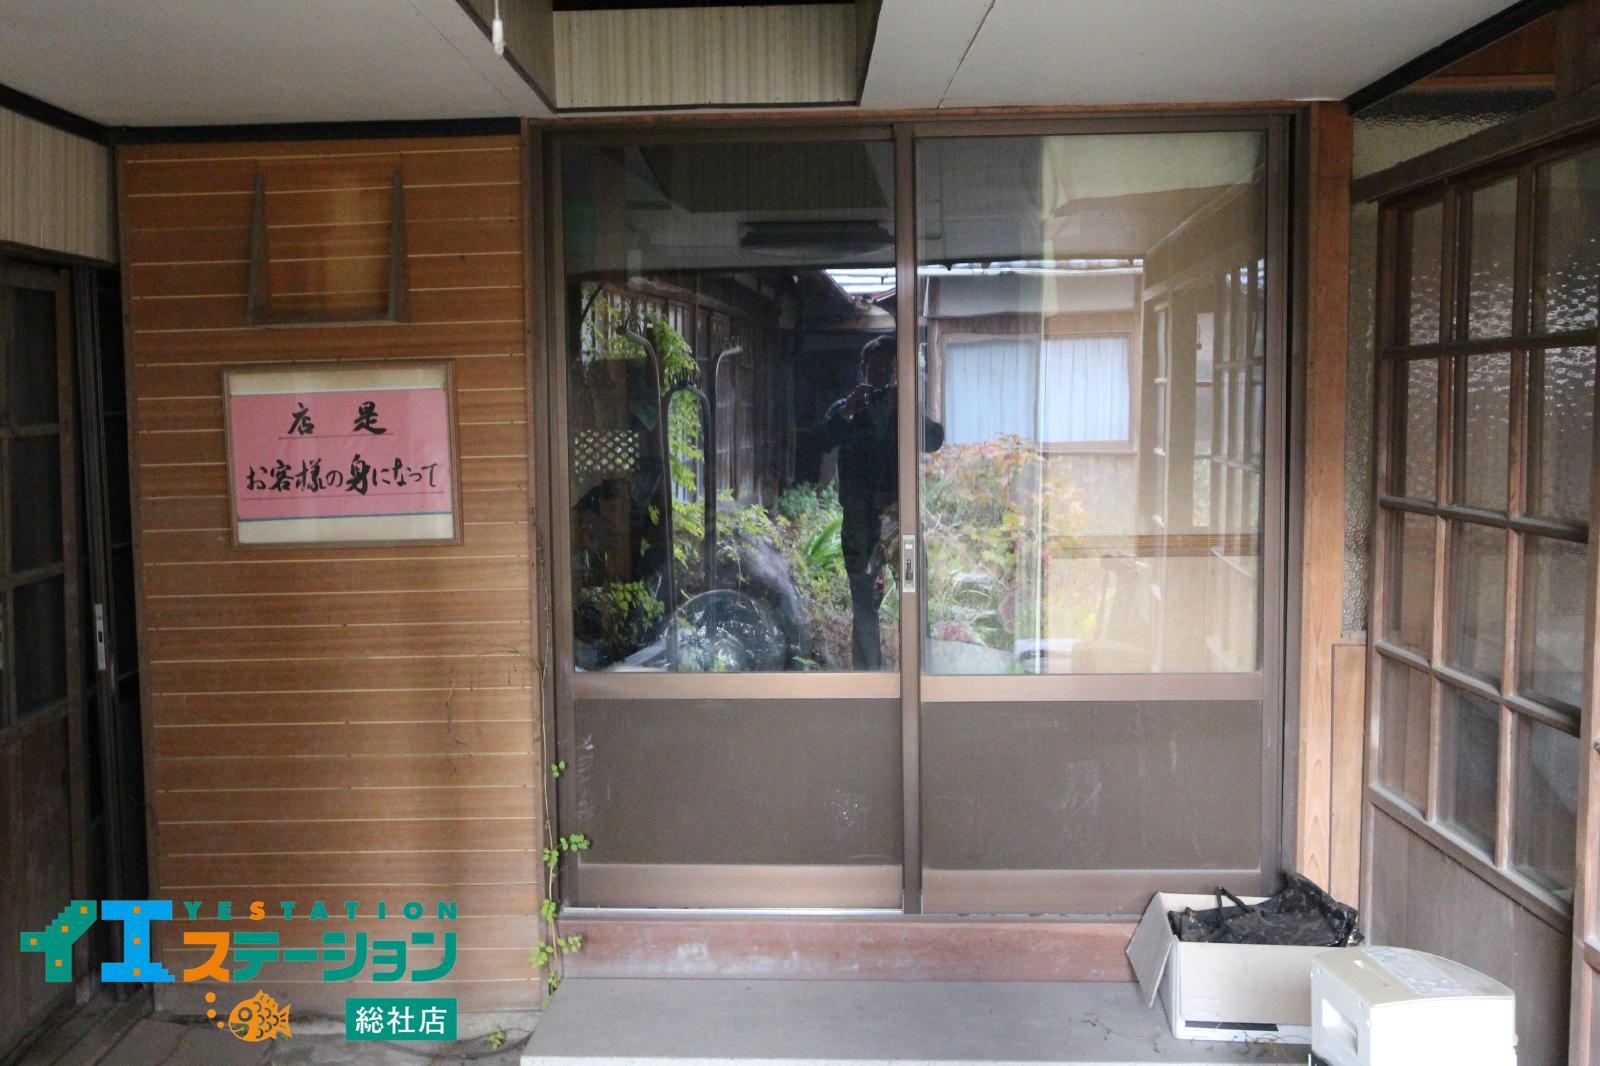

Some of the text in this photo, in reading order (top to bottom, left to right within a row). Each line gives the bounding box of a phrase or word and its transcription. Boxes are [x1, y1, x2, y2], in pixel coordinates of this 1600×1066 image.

[246, 454, 438, 495] お客様の身になって
